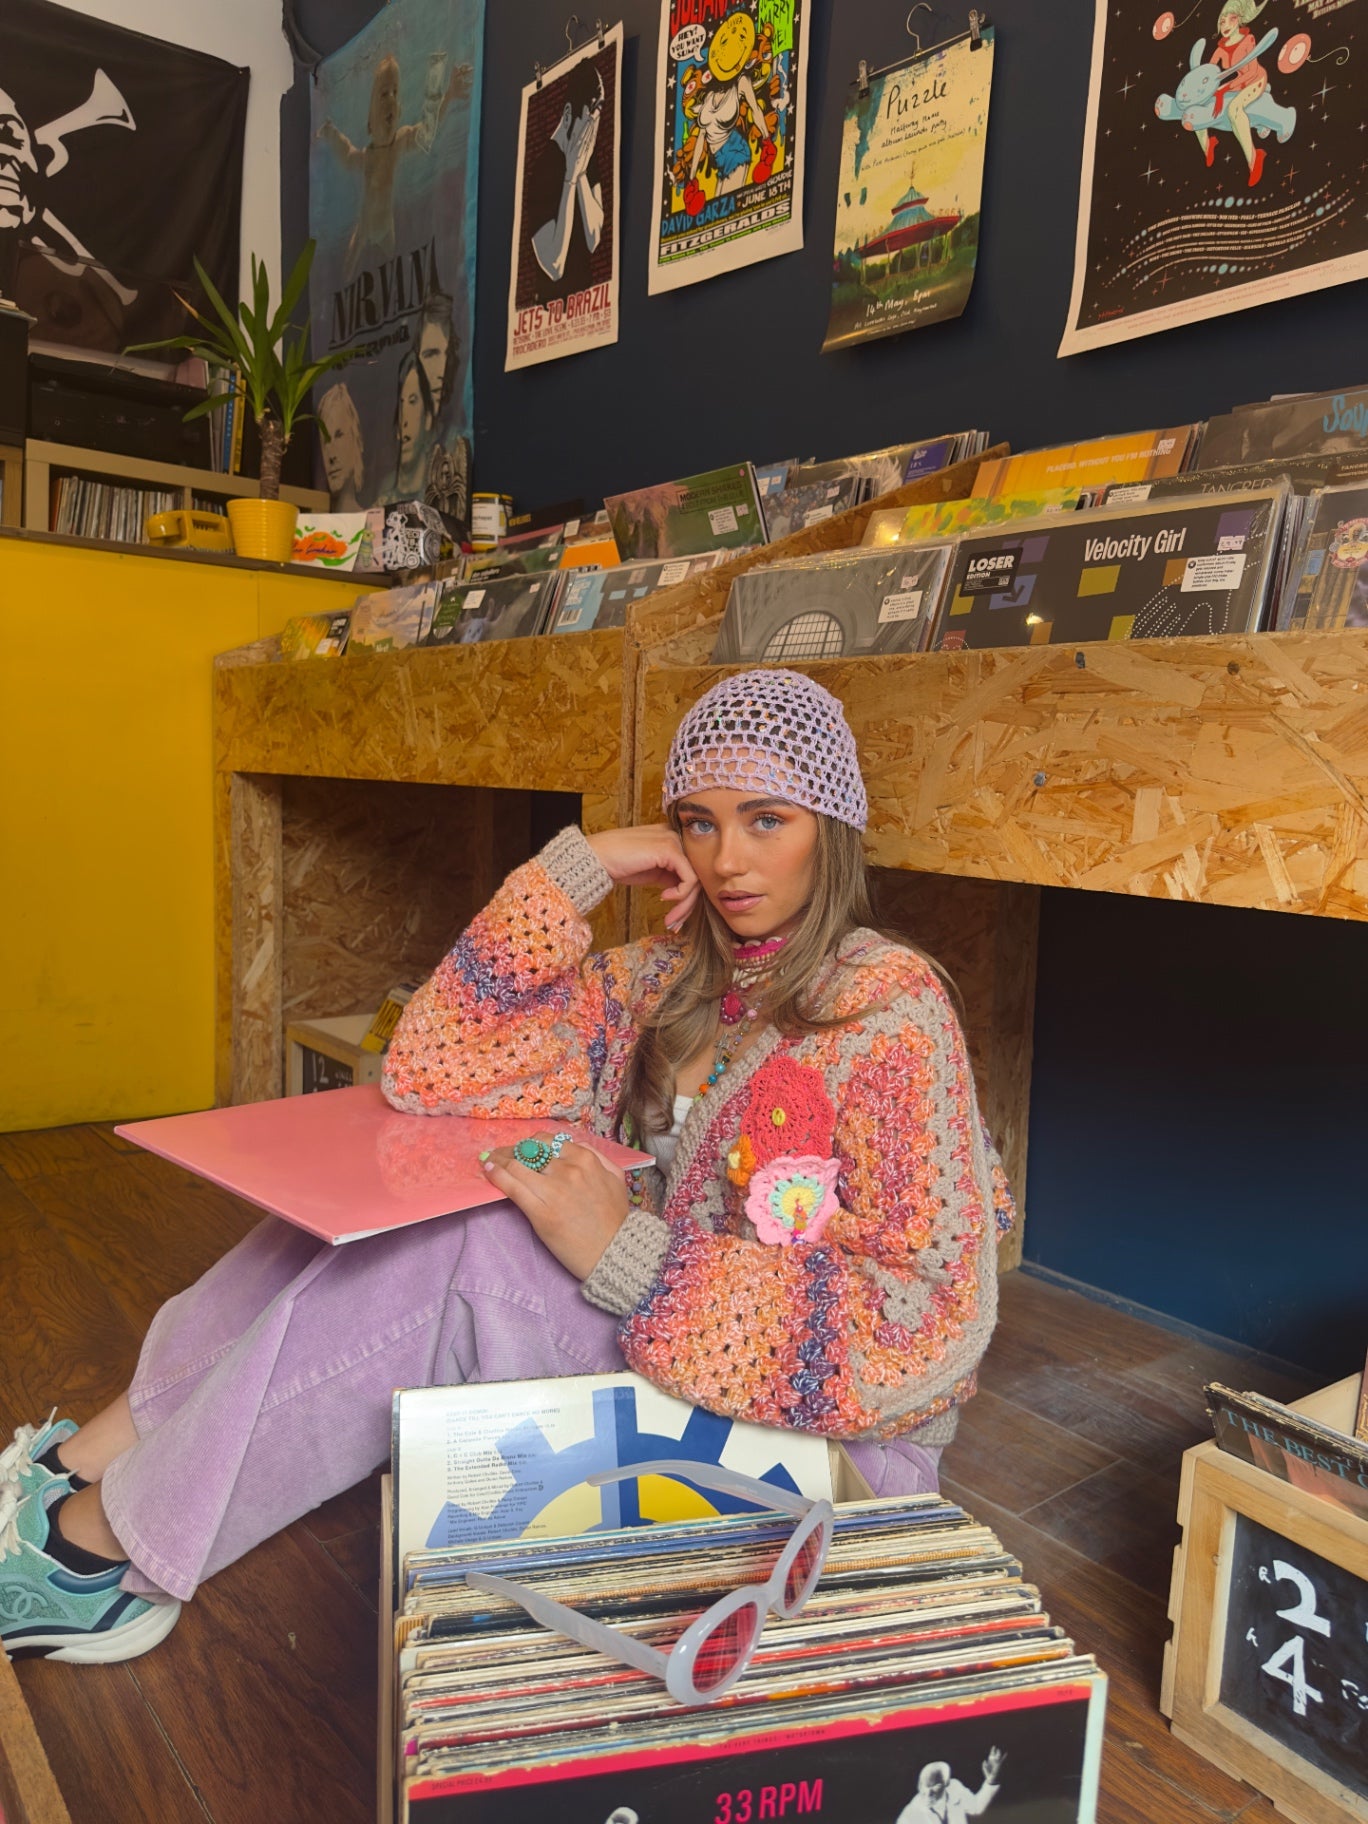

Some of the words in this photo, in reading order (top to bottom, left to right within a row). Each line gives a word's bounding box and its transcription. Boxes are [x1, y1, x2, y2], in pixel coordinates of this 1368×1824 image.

[672, 42, 685, 54] YOU
[687, 34, 704, 47] WANT
[887, 79, 947, 119] Puzzle
[661, 213, 693, 236] DAVID
[696, 196, 736, 226] GARZA
[742, 190, 766, 208] JUNE
[660, 201, 791, 257] FITZGERALDS
[329, 234, 443, 343] NIRVANA
[514, 306, 543, 336] JETS
[547, 300, 563, 326] TO
[567, 283, 611, 320] BRAZIL
[1079, 455, 1110, 467] WITHOUT
[1111, 453, 1125, 463] YOU
[1138, 448, 1172, 460] NOTHING
[968, 555, 1015, 573] LOSER
[1084, 534, 1152, 562] Velocity
[1154, 527, 1187, 554] Girl
[966, 572, 991, 580] EDITION
[1221, 1407, 1280, 1447] THE
[1283, 1436, 1350, 1478] BEST
[714, 1789, 753, 1824] 33
[759, 1778, 824, 1819] RPM
